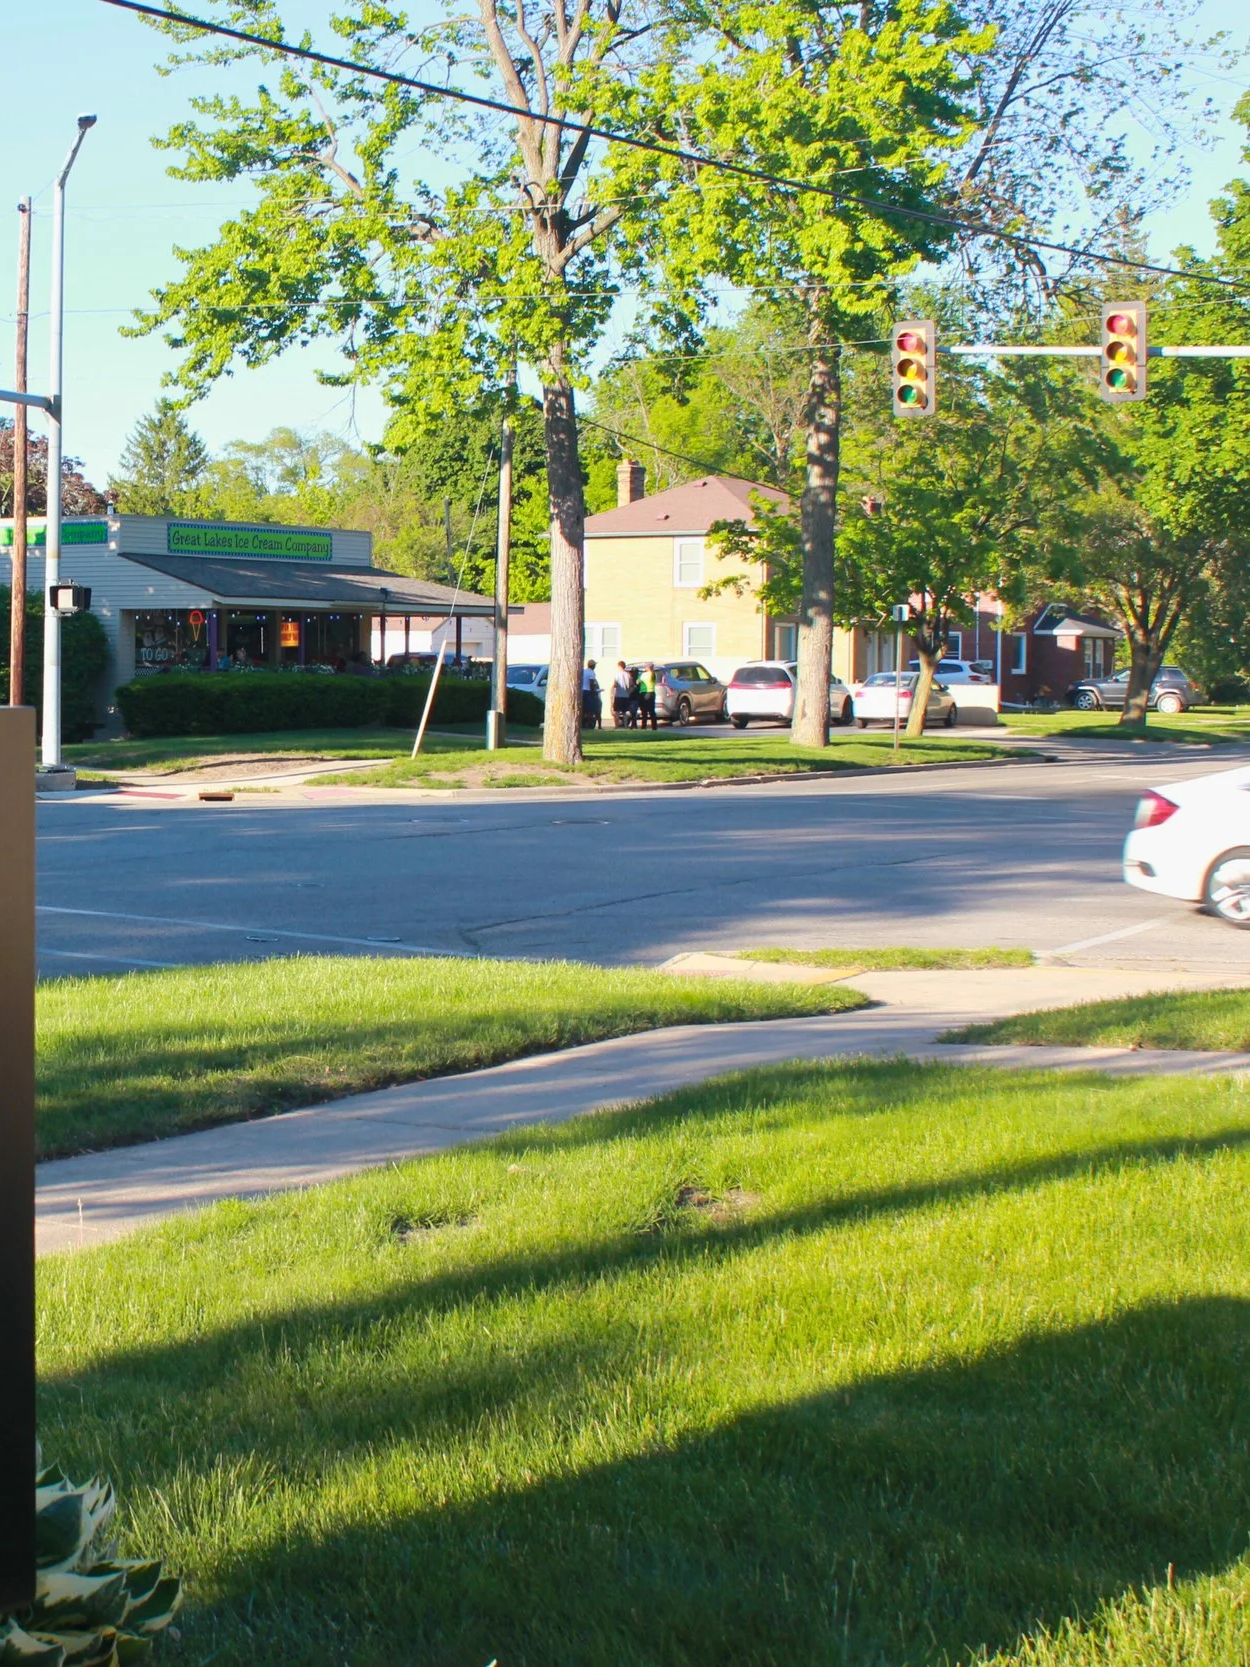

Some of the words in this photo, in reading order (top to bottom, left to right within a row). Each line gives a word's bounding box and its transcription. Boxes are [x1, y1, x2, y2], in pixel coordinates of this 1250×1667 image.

[172, 530, 201, 546] Great
[204, 532, 233, 549] Lakes
[235, 533, 249, 549] Ice
[251, 535, 283, 551] Cream
[285, 537, 329, 557] Company
[140, 647, 153, 661] TO
[155, 647, 169, 661] GO
